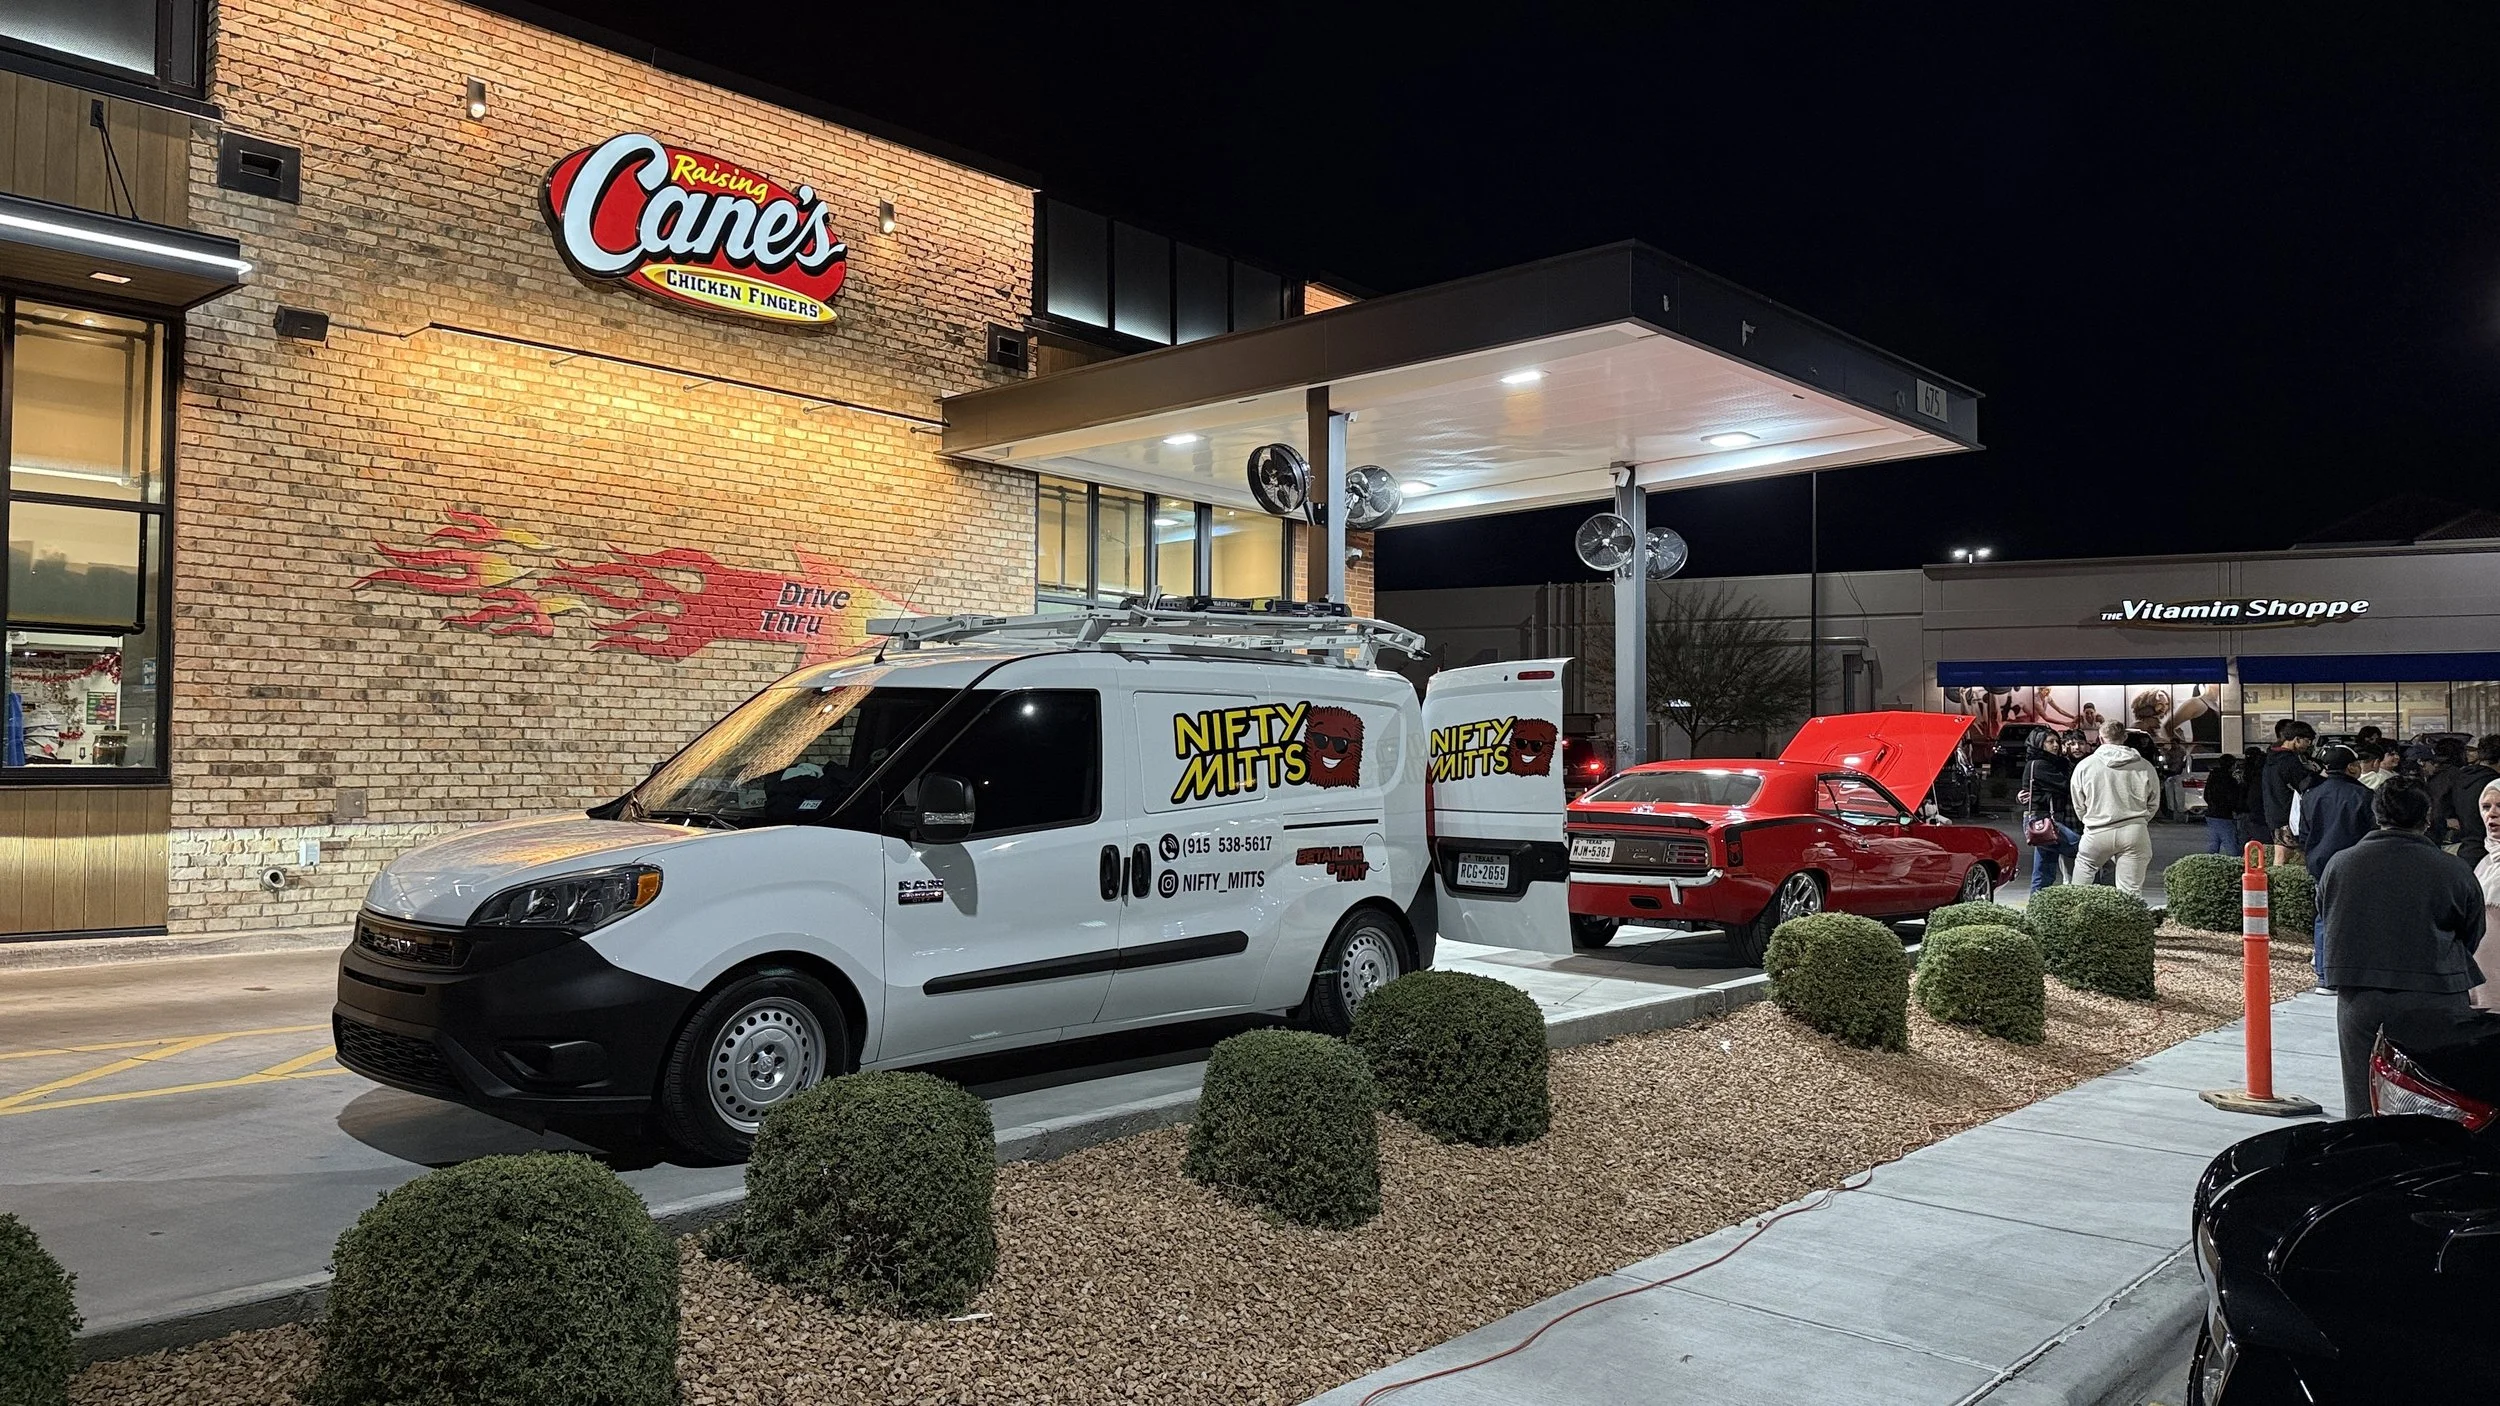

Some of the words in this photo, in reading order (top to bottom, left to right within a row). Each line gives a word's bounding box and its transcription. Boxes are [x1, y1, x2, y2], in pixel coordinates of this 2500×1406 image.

[671, 154, 770, 204] Raising
[563, 133, 847, 272] Cane's
[666, 268, 742, 301] CHICKEN
[748, 286, 819, 318] FINGERS
[1924, 385, 1940, 417] 675
[778, 582, 851, 610] Drive
[2101, 612, 2122, 621] THE
[2121, 599, 2240, 621] Vitamin
[2246, 599, 2371, 619] Shoppe
[761, 609, 823, 635] Thru
[1174, 702, 1309, 757] NIFTY
[1431, 716, 1516, 757] NIFTY
[1172, 743, 1308, 802] MITTS
[1431, 745, 1510, 781] MITTS
[1218, 836, 1272, 853] 538-5617
[1183, 870, 1265, 893] NIFTY_MITTS
[1336, 862, 1368, 881] TINT
